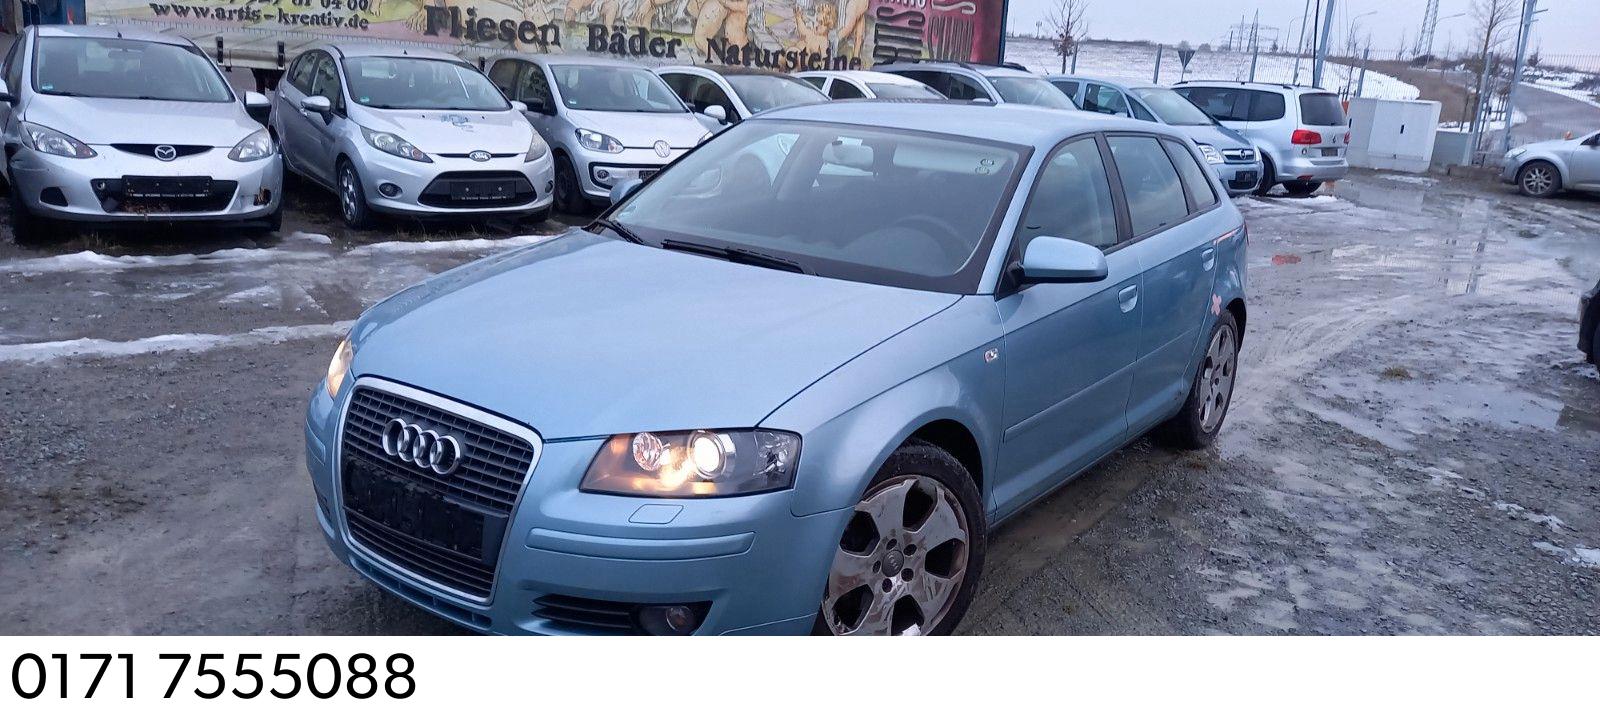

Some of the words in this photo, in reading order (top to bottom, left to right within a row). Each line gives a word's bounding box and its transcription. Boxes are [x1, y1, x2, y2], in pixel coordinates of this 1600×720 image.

[424, 5, 560, 46] Fliesen
[586, 18, 682, 58] Bäder
[704, 37, 863, 71] Natursteine
